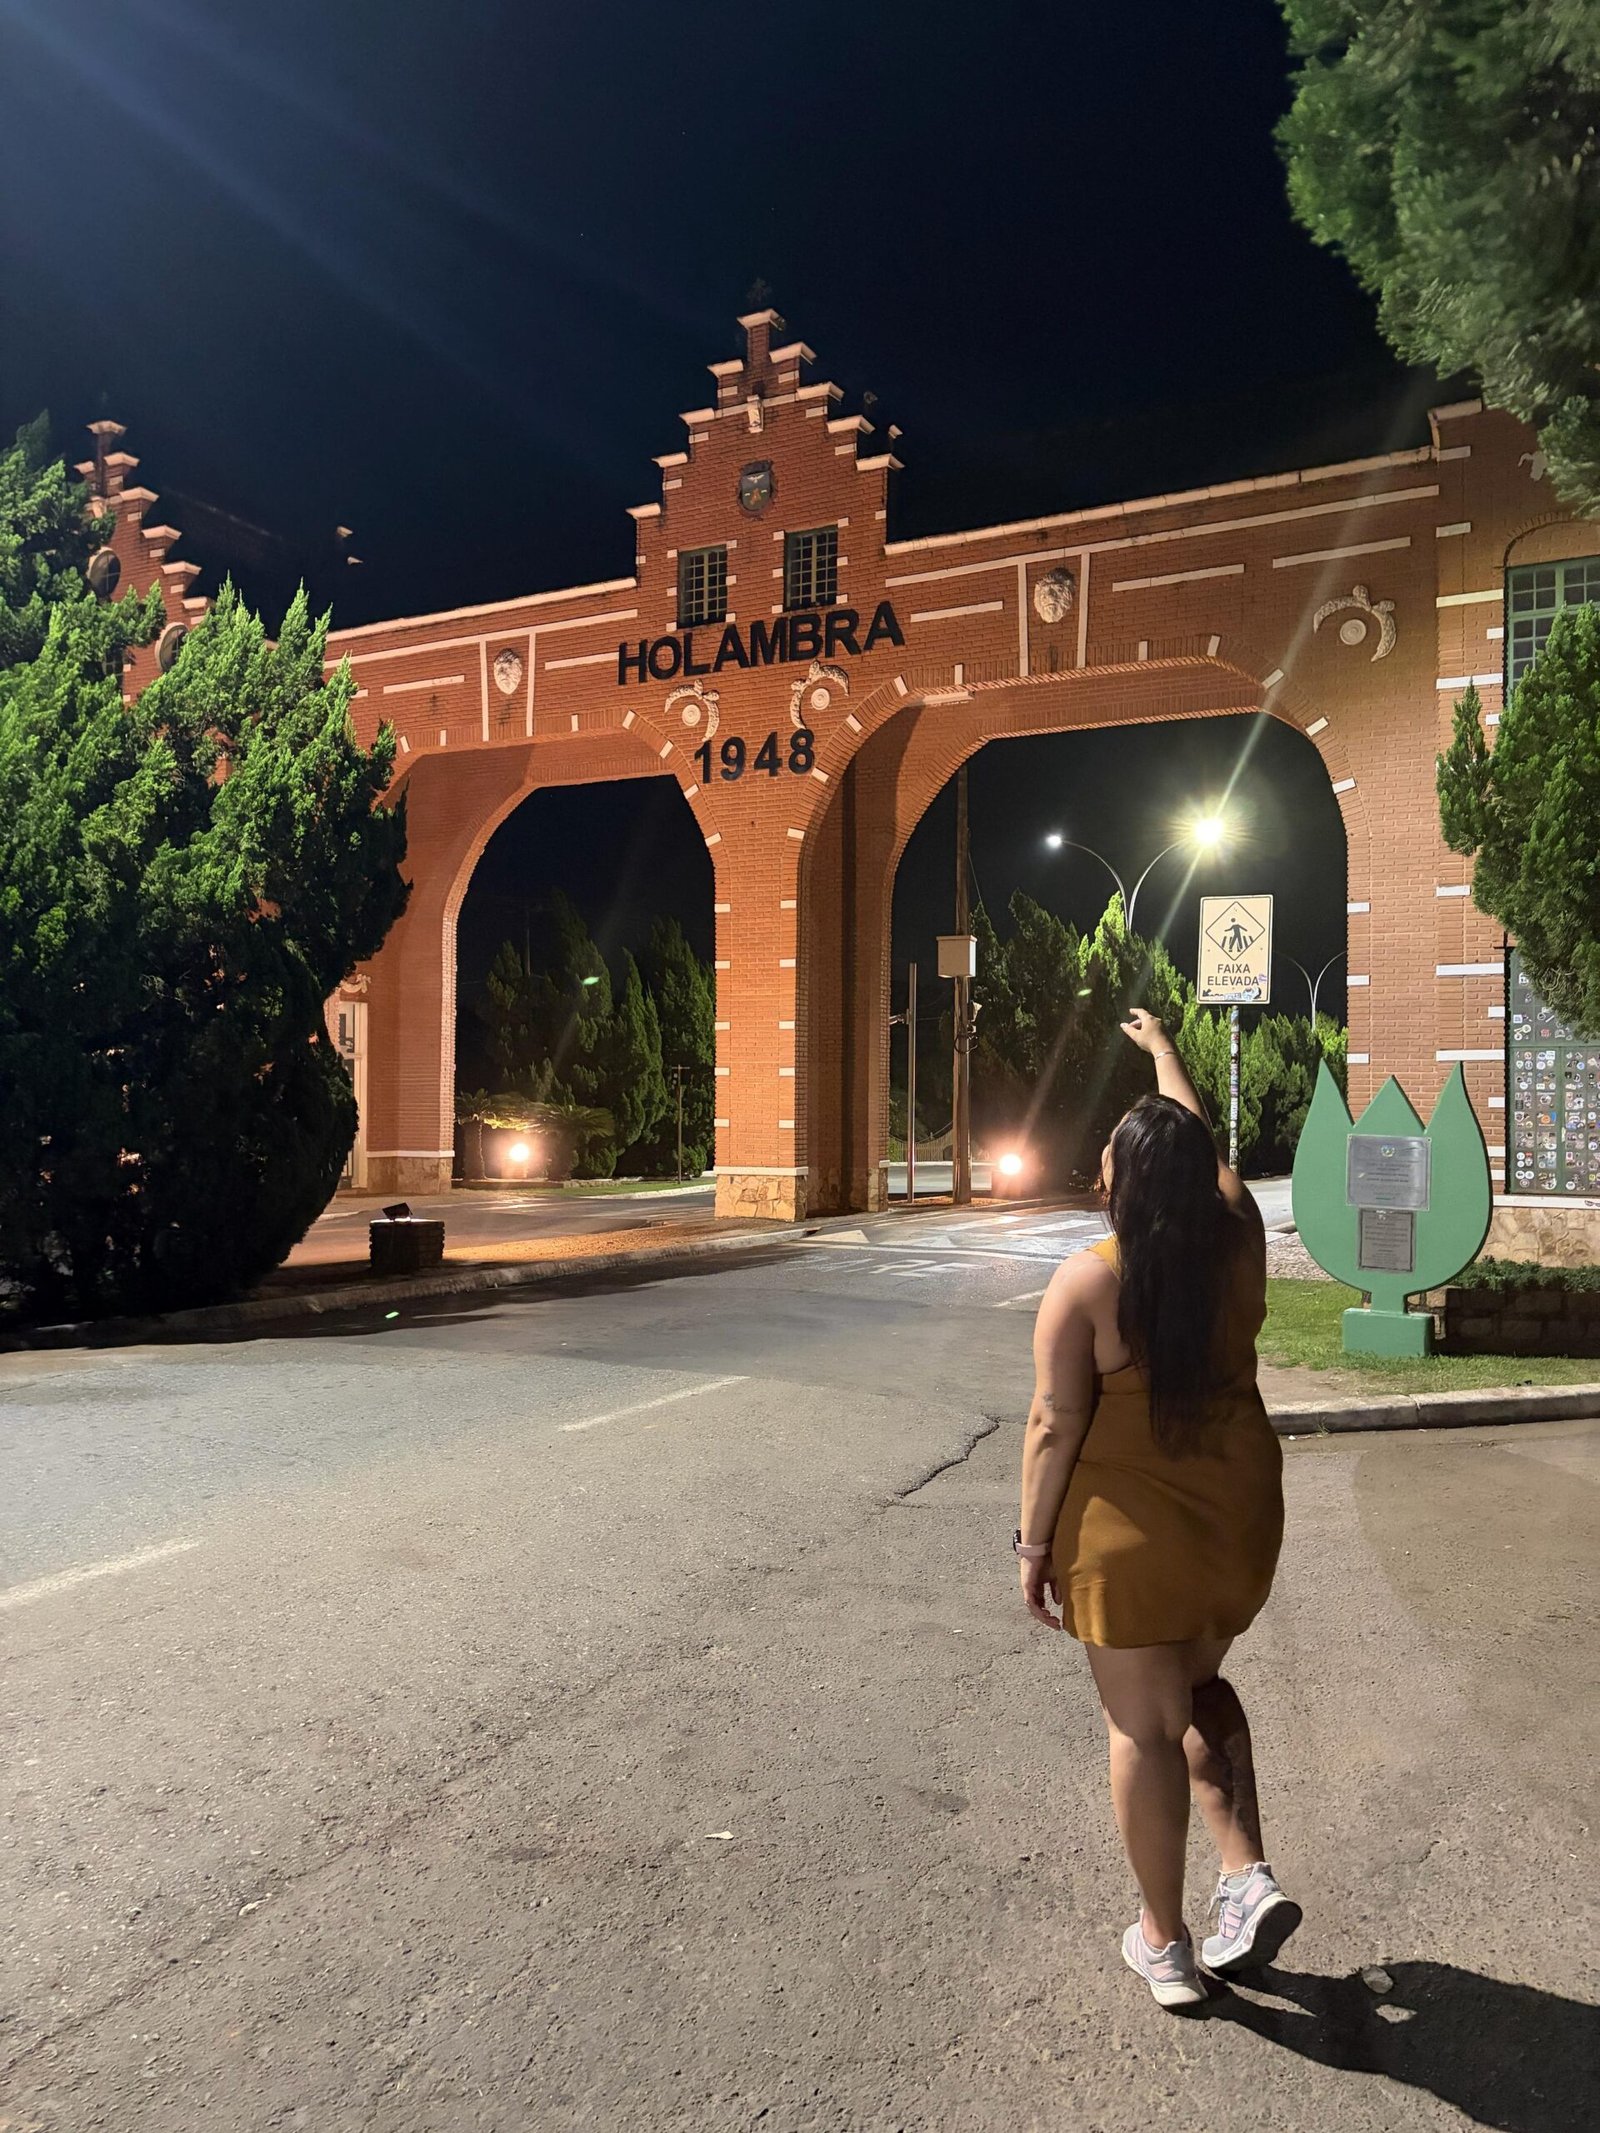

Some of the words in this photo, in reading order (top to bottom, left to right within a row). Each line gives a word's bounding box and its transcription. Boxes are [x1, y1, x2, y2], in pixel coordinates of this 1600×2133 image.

[618, 601, 905, 685] HOLAMBRA
[694, 728, 815, 784] 1948
[1207, 975, 1259, 986] ELEVADA
[1217, 963, 1250, 973] FAIXA
